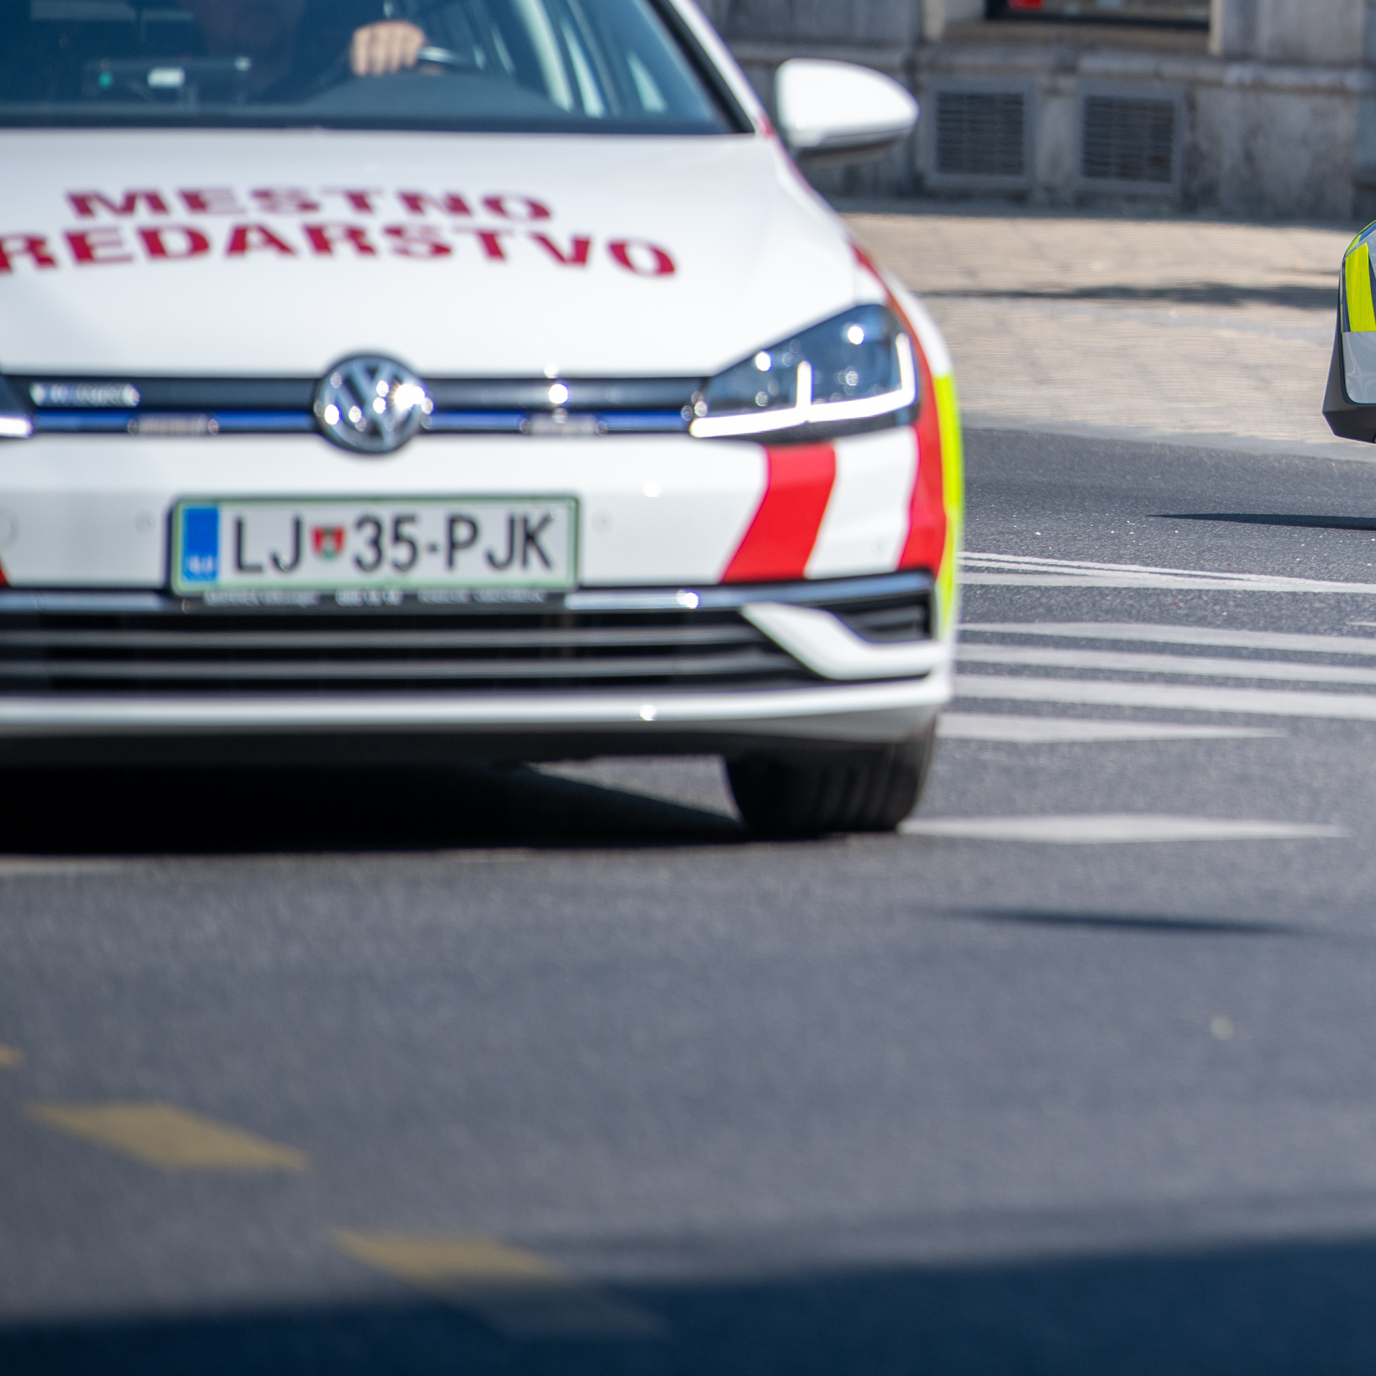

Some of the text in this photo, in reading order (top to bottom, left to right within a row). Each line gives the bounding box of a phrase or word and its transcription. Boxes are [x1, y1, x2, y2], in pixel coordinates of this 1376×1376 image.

[64, 187, 553, 222] MESTNO
[0, 223, 677, 280] REDARSTVO
[234, 513, 554, 573] LJ 35-PJK
